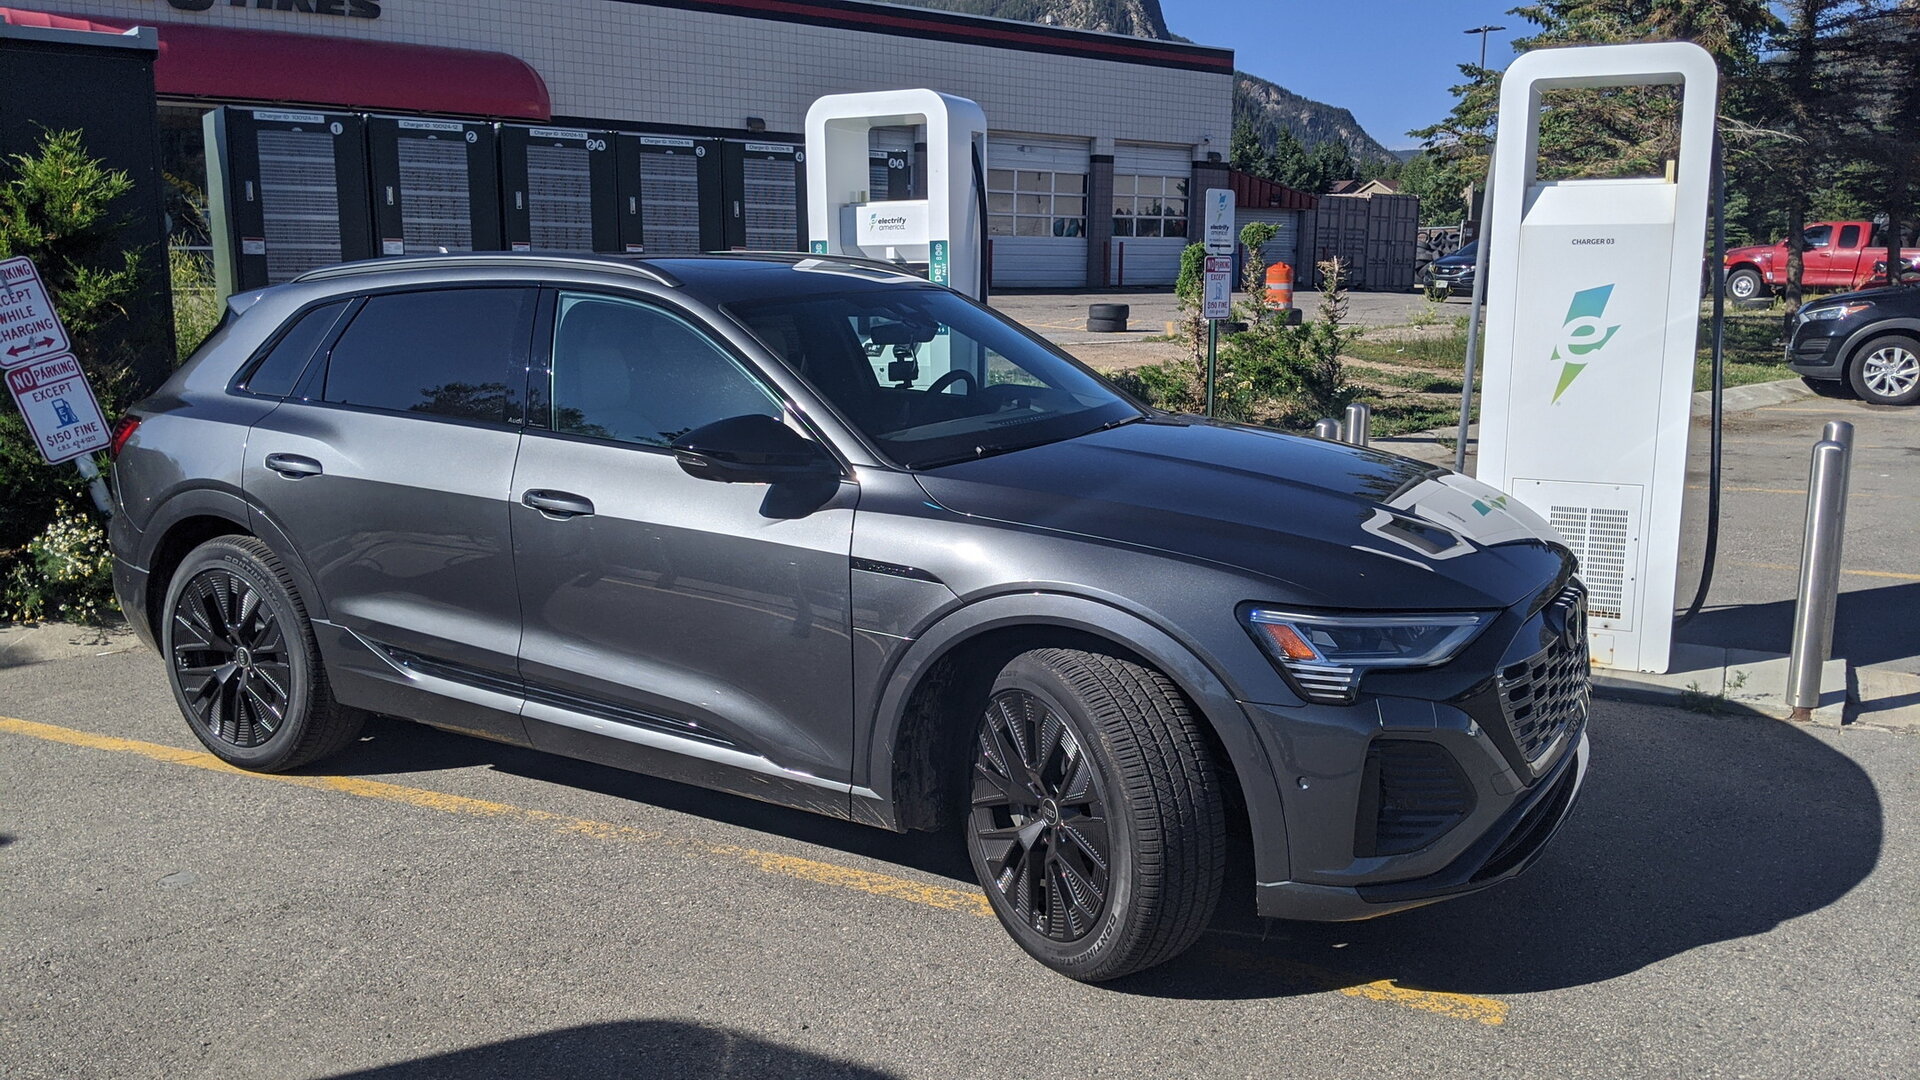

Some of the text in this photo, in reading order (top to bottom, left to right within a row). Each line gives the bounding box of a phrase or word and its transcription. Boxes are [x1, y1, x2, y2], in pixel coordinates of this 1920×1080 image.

[229, 0, 382, 19] RES
[259, 112, 282, 120] Charger
[403, 121, 422, 129] Charger
[878, 216, 907, 225] electrify
[1207, 259, 1215, 271] NO
[1210, 273, 1227, 281] EXCEPT
[0, 288, 32, 307] CEPT
[0, 318, 53, 343] HARGING
[11, 360, 75, 390] NO PARKING
[32, 382, 73, 403] EXCEPT
[46, 421, 99, 447] $150 FINE
